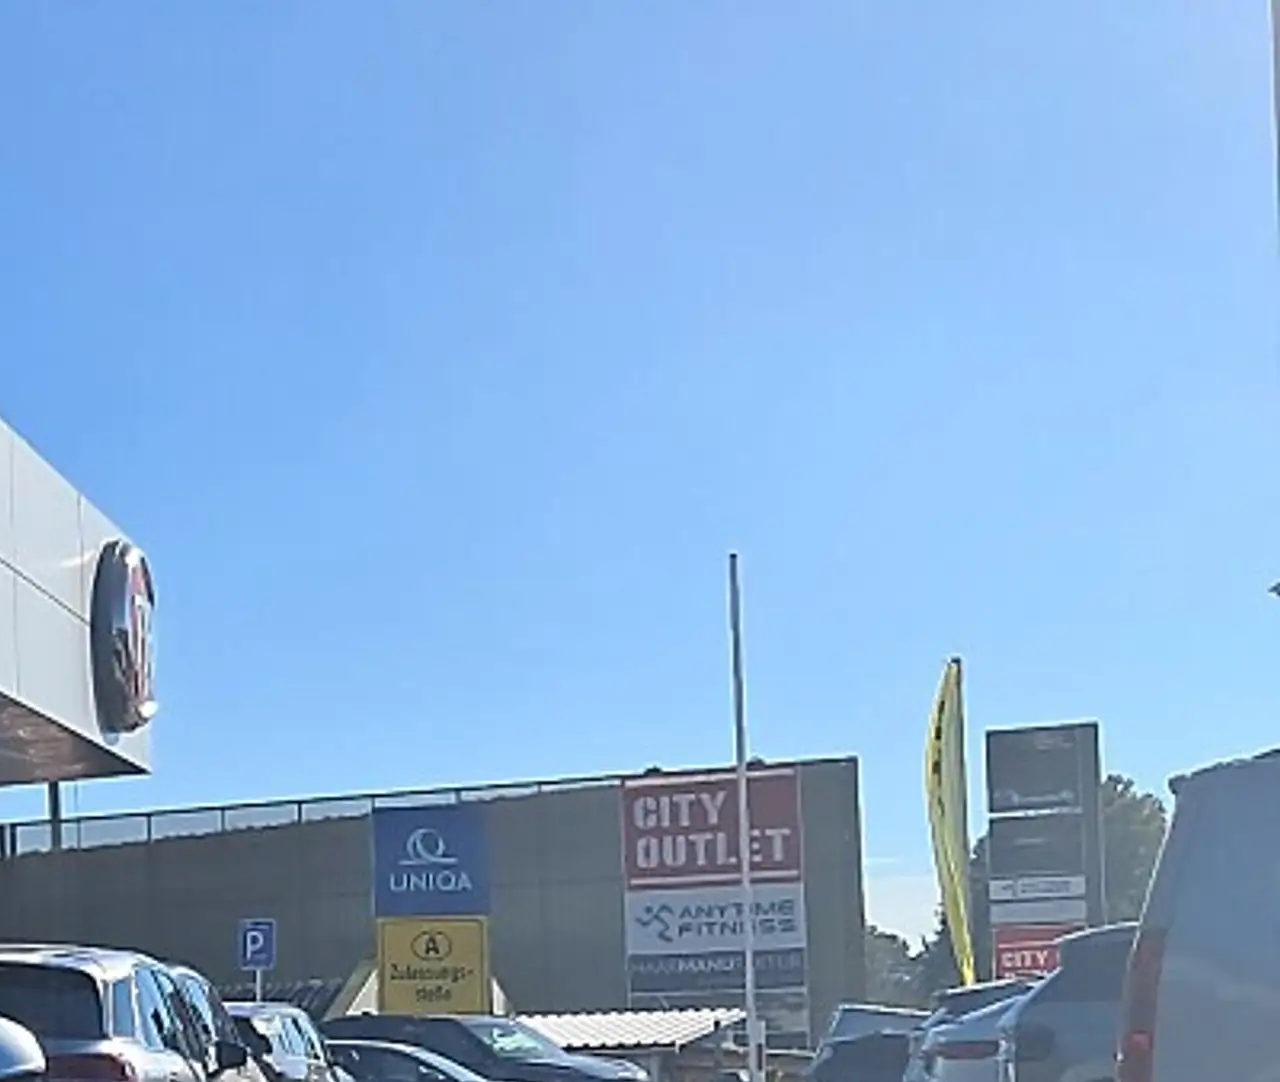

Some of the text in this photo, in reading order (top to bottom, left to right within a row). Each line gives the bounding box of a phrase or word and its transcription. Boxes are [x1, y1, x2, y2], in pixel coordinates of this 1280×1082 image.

[633, 790, 728, 829] CITY
[390, 870, 473, 892] UNIQA
[246, 931, 264, 960] P
[1001, 950, 1048, 967] CITY
